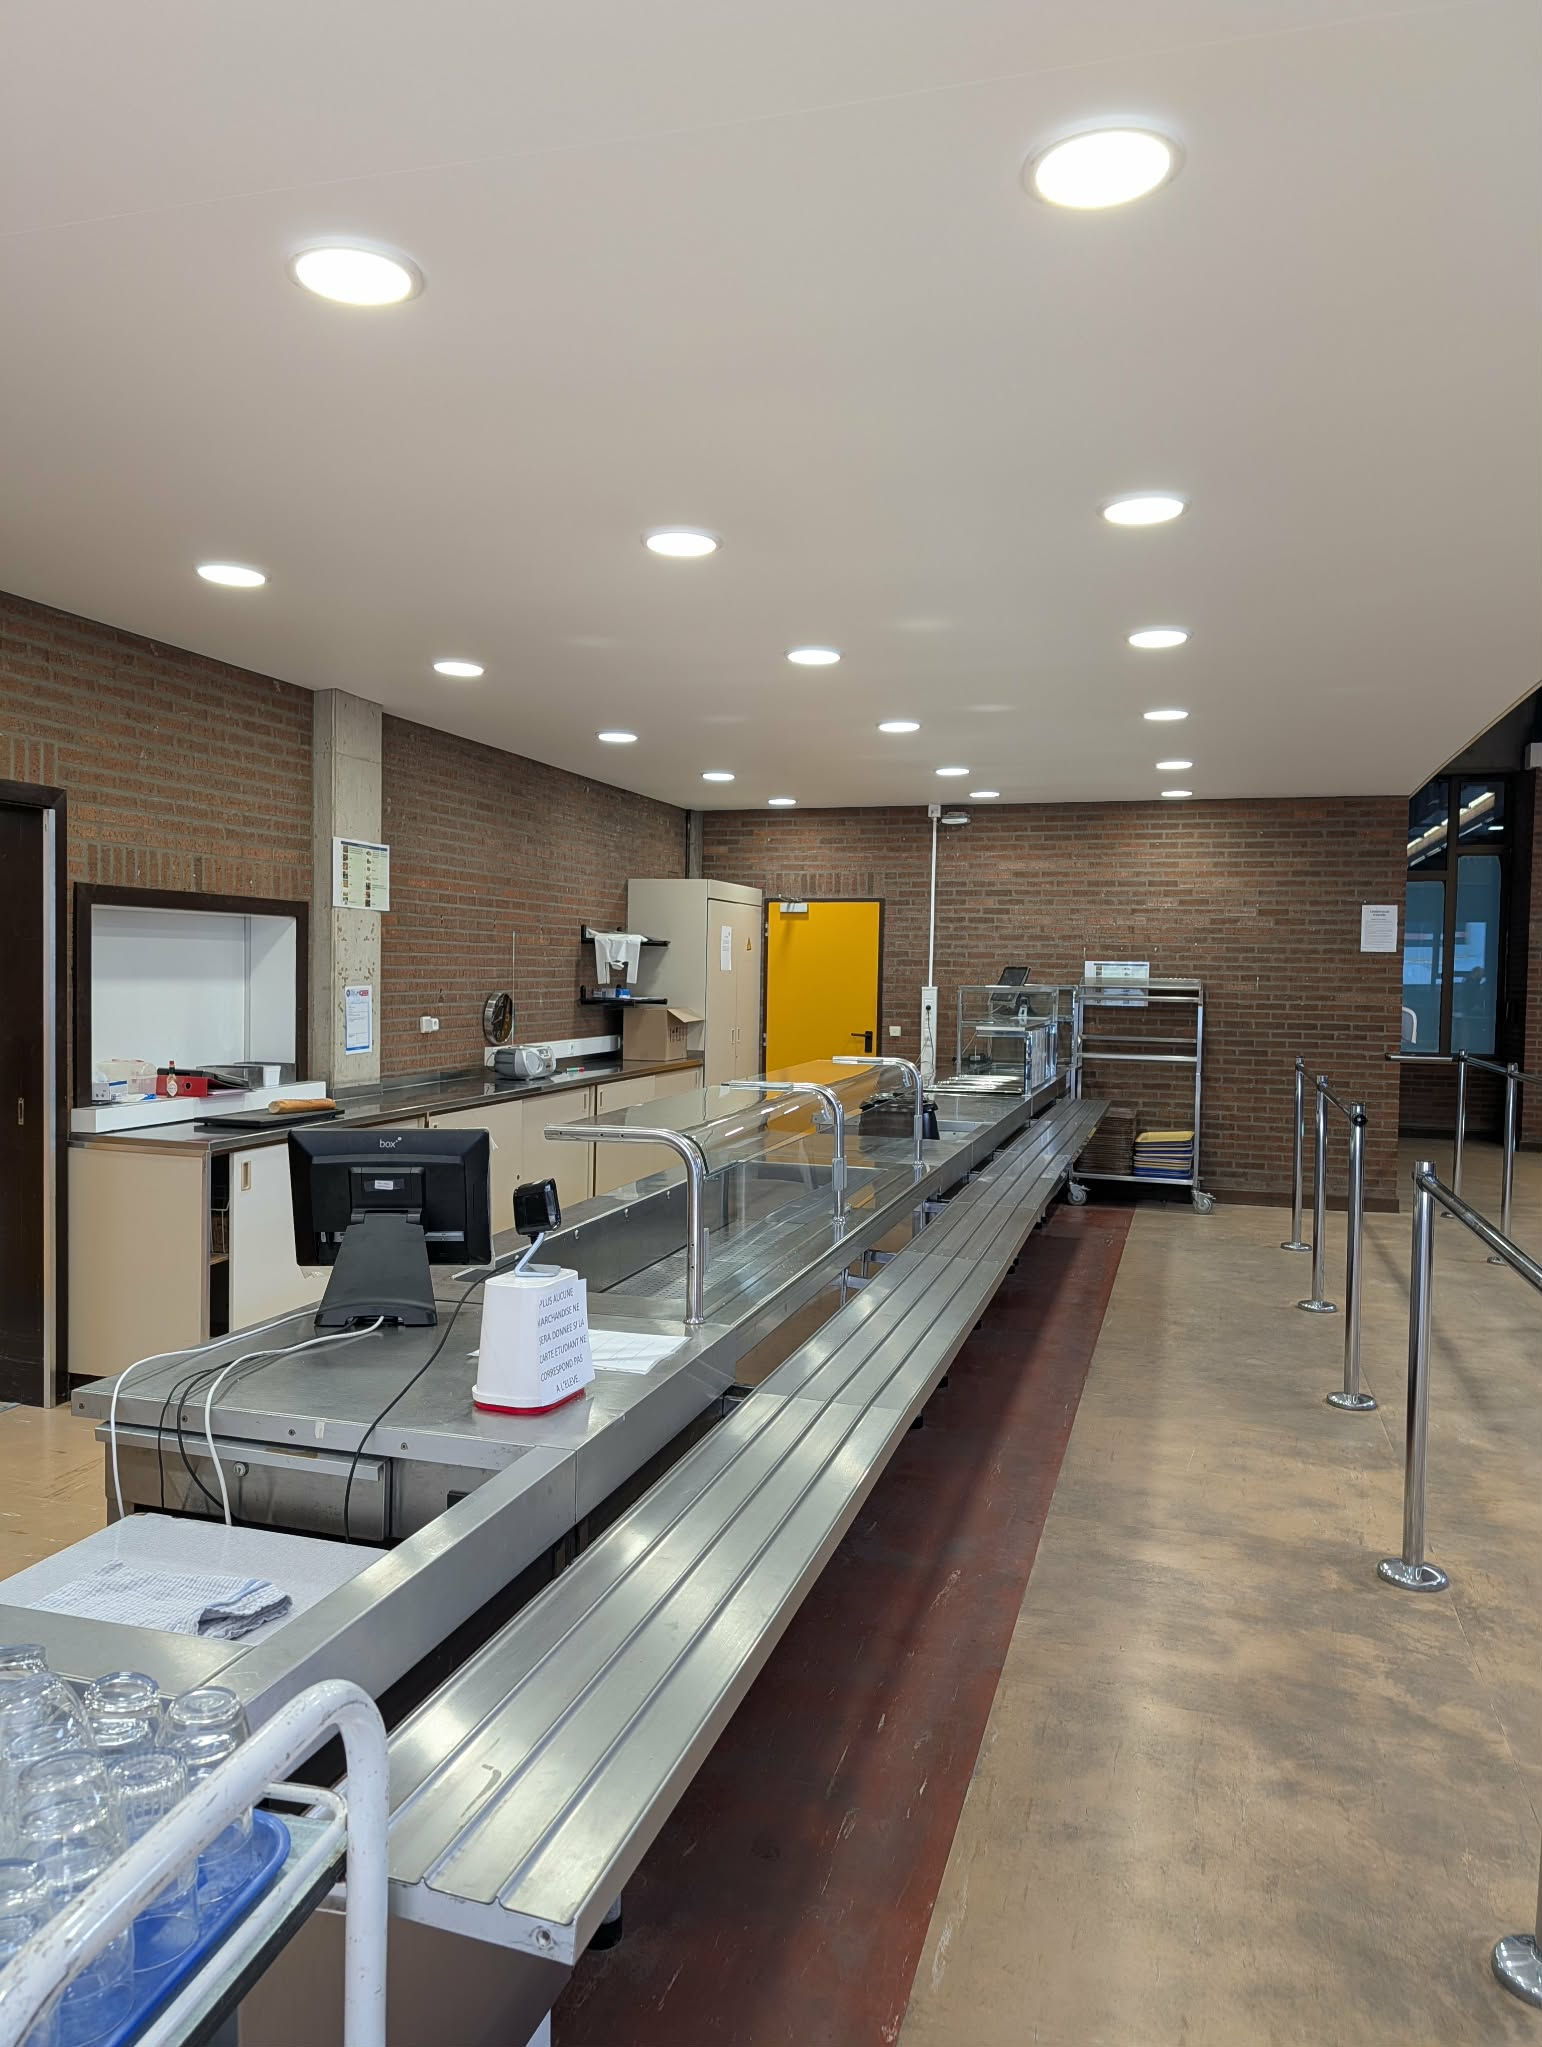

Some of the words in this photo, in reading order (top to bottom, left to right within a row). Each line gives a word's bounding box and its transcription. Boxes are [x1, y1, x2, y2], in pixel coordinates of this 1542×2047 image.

[379, 1138, 396, 1148] box
[539, 1296, 553, 1309] PLUS
[553, 1287, 574, 1303] AUCUNE
[573, 1302, 580, 1313] NE
[539, 1332, 551, 1345] SERA
[552, 1323, 573, 1340] DONNEE
[573, 1320, 578, 1330] SI
[579, 1317, 585, 1328] LA
[539, 1349, 555, 1365] CARTE
[555, 1338, 579, 1357] ETUDIANT
[580, 1334, 587, 1346] NE
[540, 1358, 574, 1382] CORRESPOND
[574, 1353, 584, 1365] PAS
